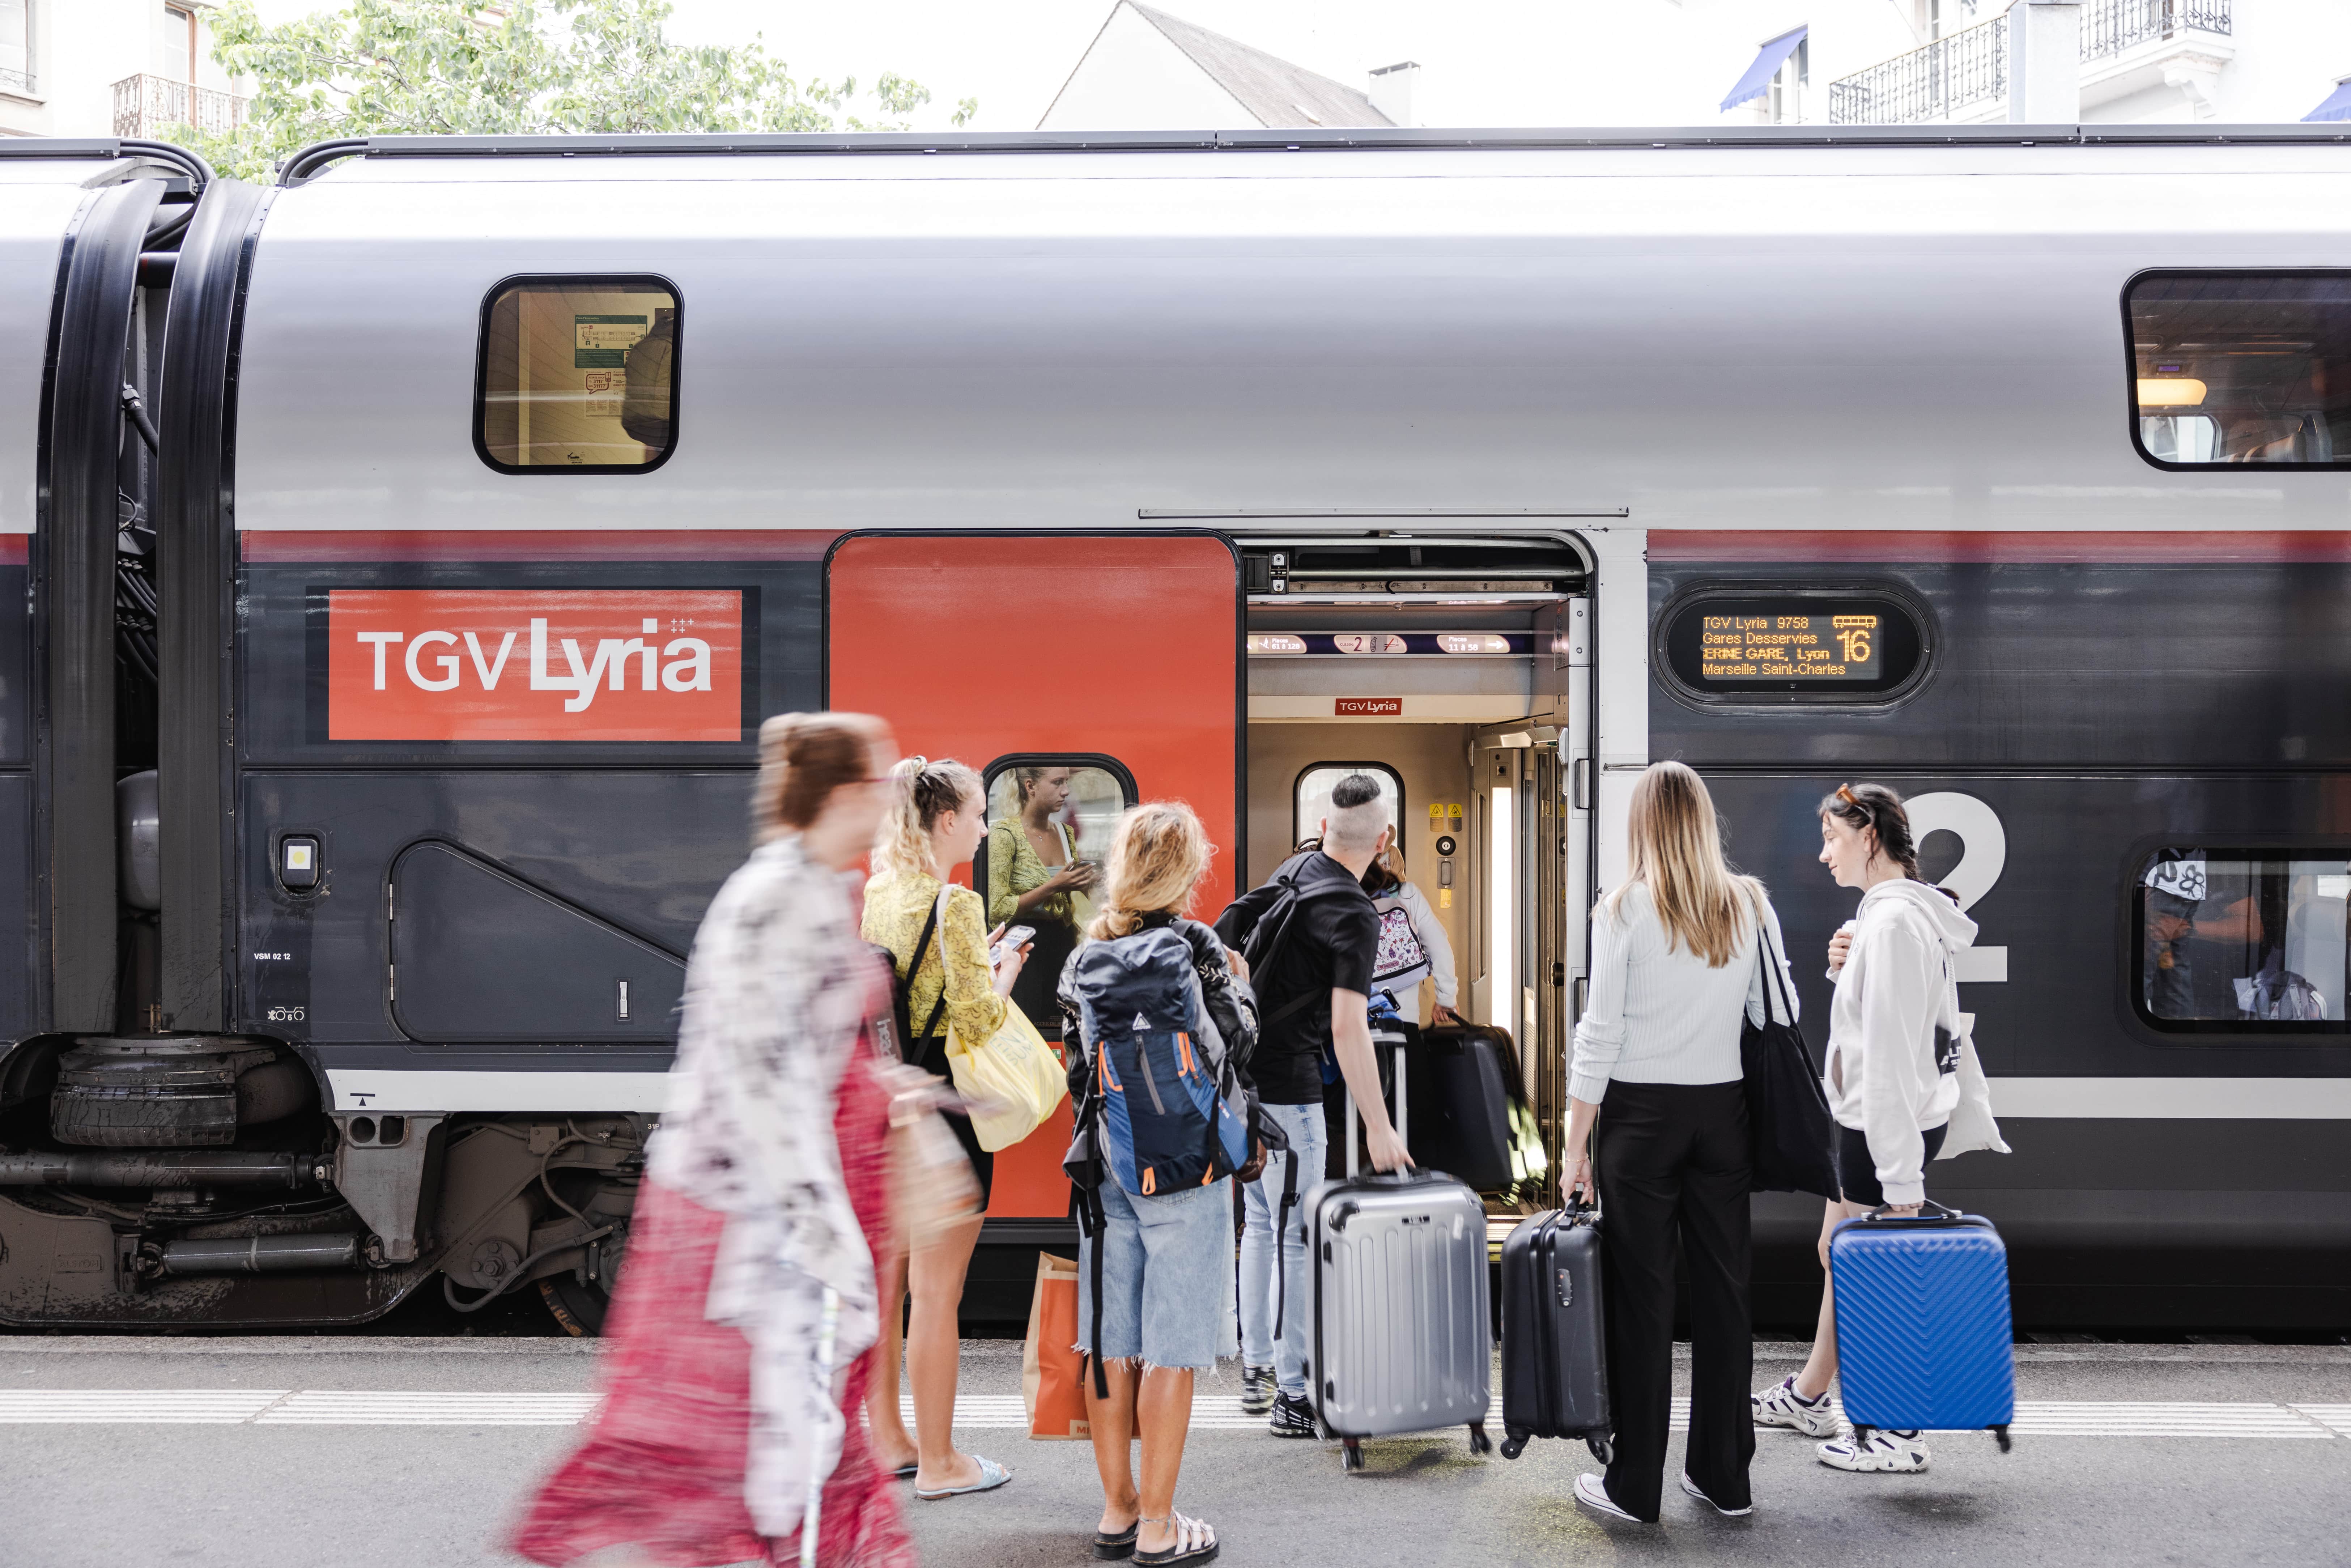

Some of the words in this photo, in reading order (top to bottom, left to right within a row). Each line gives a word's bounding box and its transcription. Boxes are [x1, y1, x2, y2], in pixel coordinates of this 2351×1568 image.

[1703, 617, 1731, 628] TGV
[1736, 617, 1767, 631] Lyria
[1777, 617, 1808, 628] 9758
[1353, 637, 1362, 651] 2
[1703, 633, 1741, 644] Gares
[1747, 633, 1818, 644] Desservies
[1837, 630, 1870, 662] 16
[1797, 648, 1830, 662] Lyon
[357, 630, 517, 692] TGV
[531, 618, 712, 712] Lyria
[1703, 663, 1757, 675] Marseille
[1762, 663, 1846, 675] Saint-Charles
[1367, 701, 1397, 713] Lyria
[1902, 791, 2007, 982] 2
